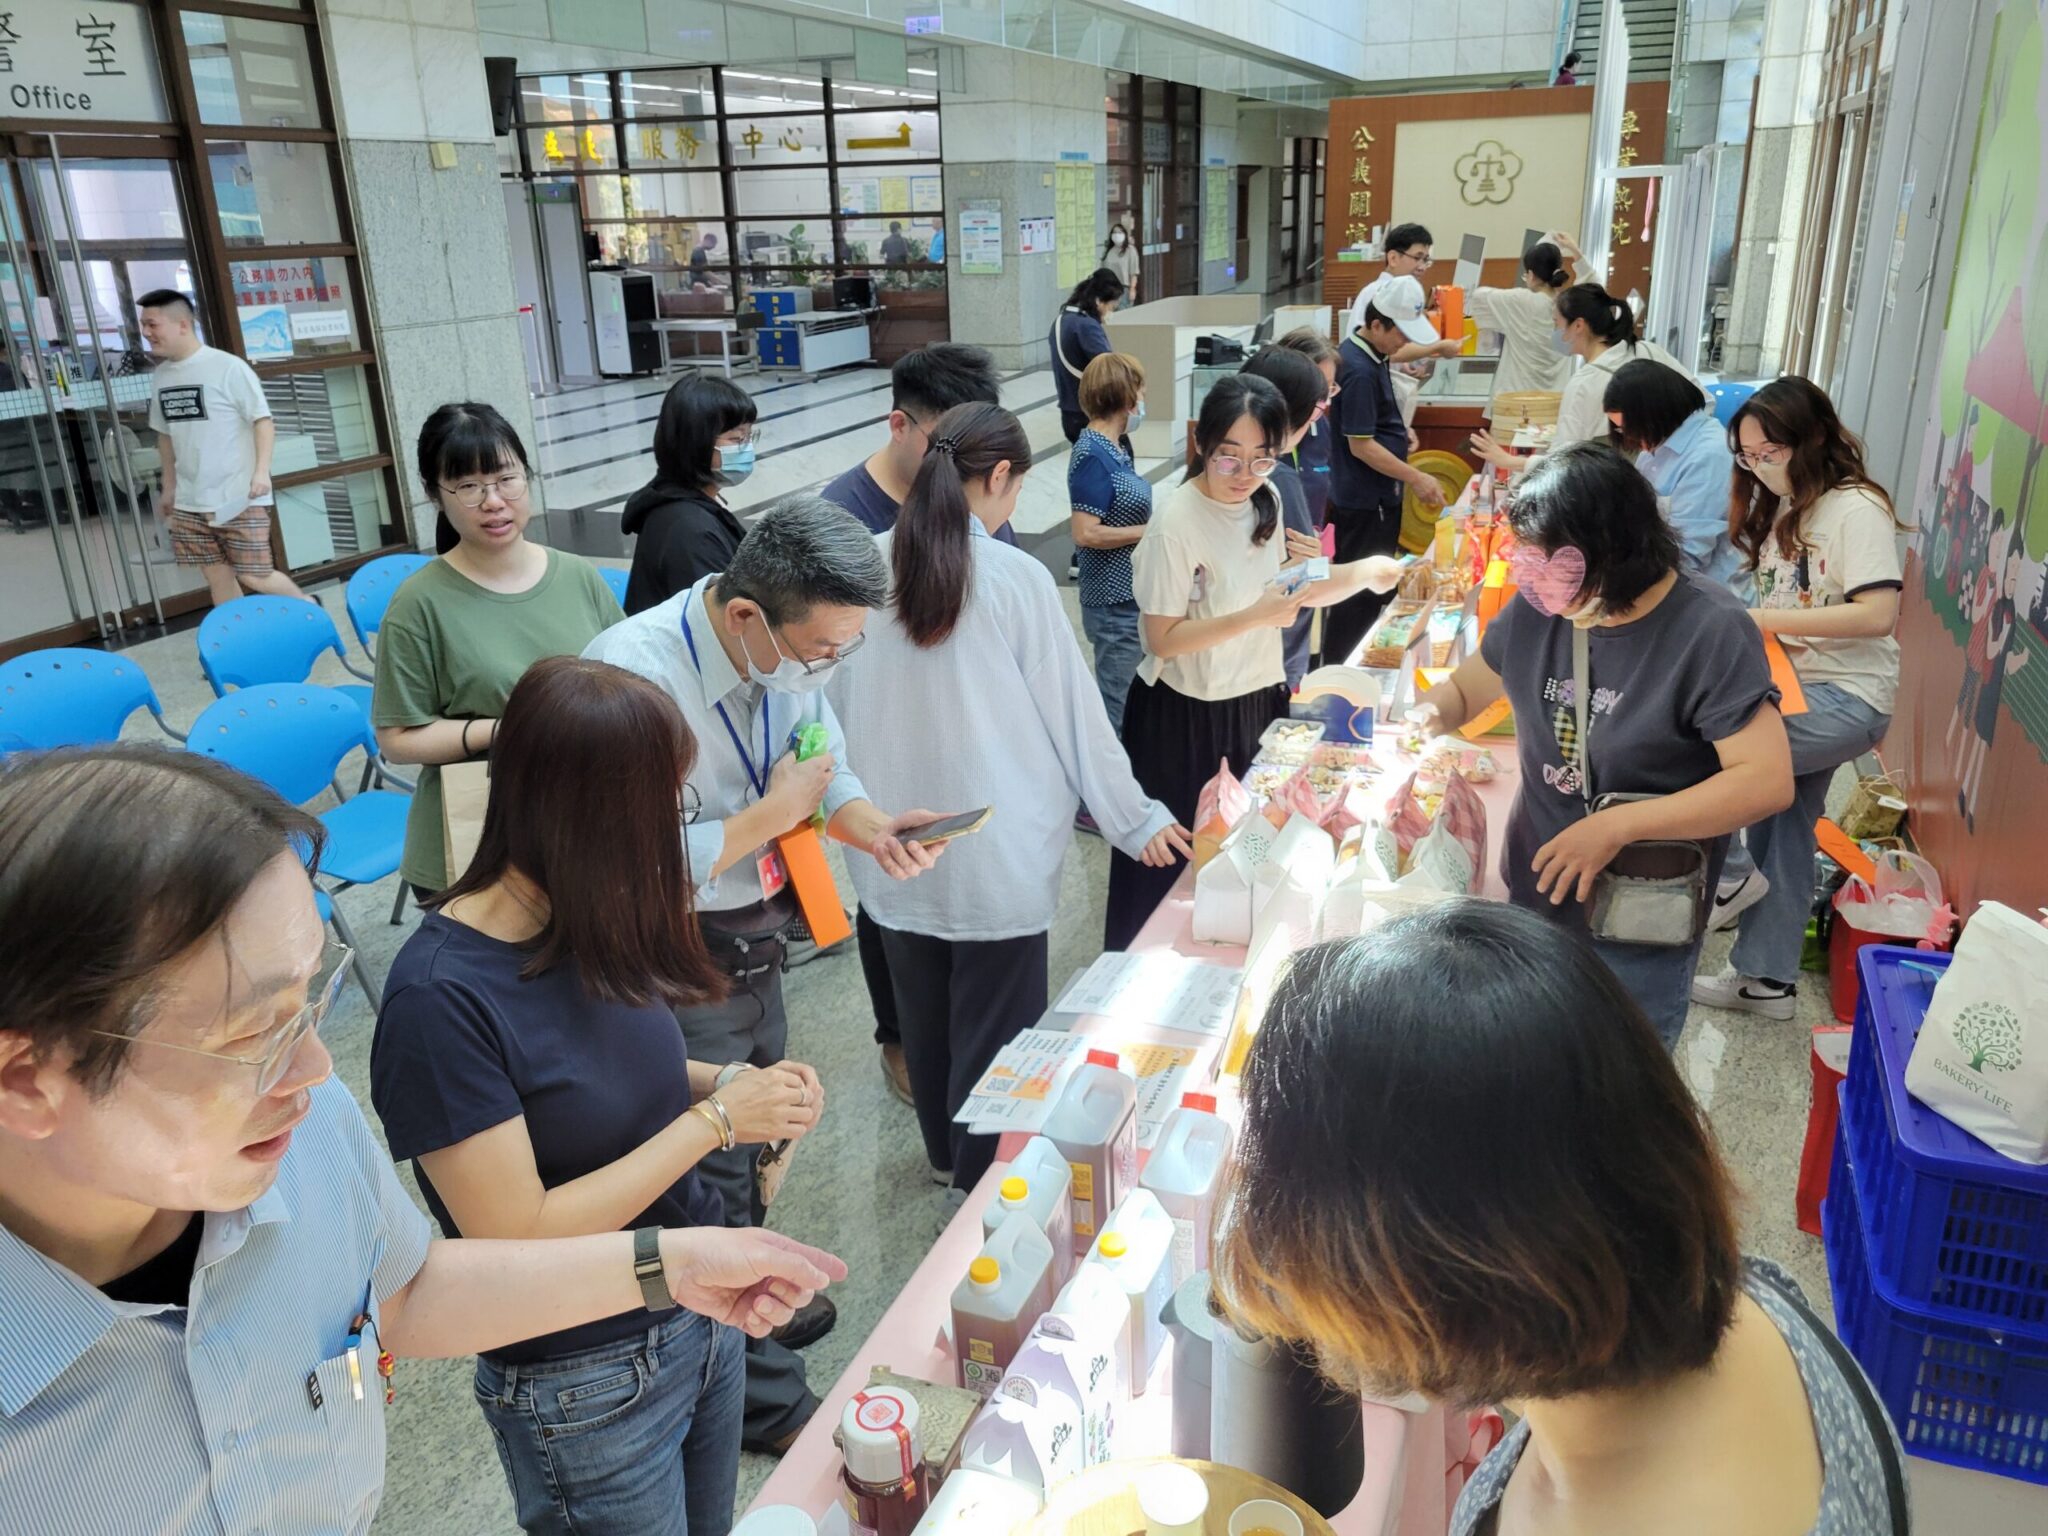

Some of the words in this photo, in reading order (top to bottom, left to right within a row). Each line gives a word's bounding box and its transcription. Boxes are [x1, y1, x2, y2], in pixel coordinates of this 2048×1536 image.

[10, 84, 92, 111] Office
[1933, 1058, 1984, 1094] BAKERY
[1984, 1090, 2013, 1114] LIFE
